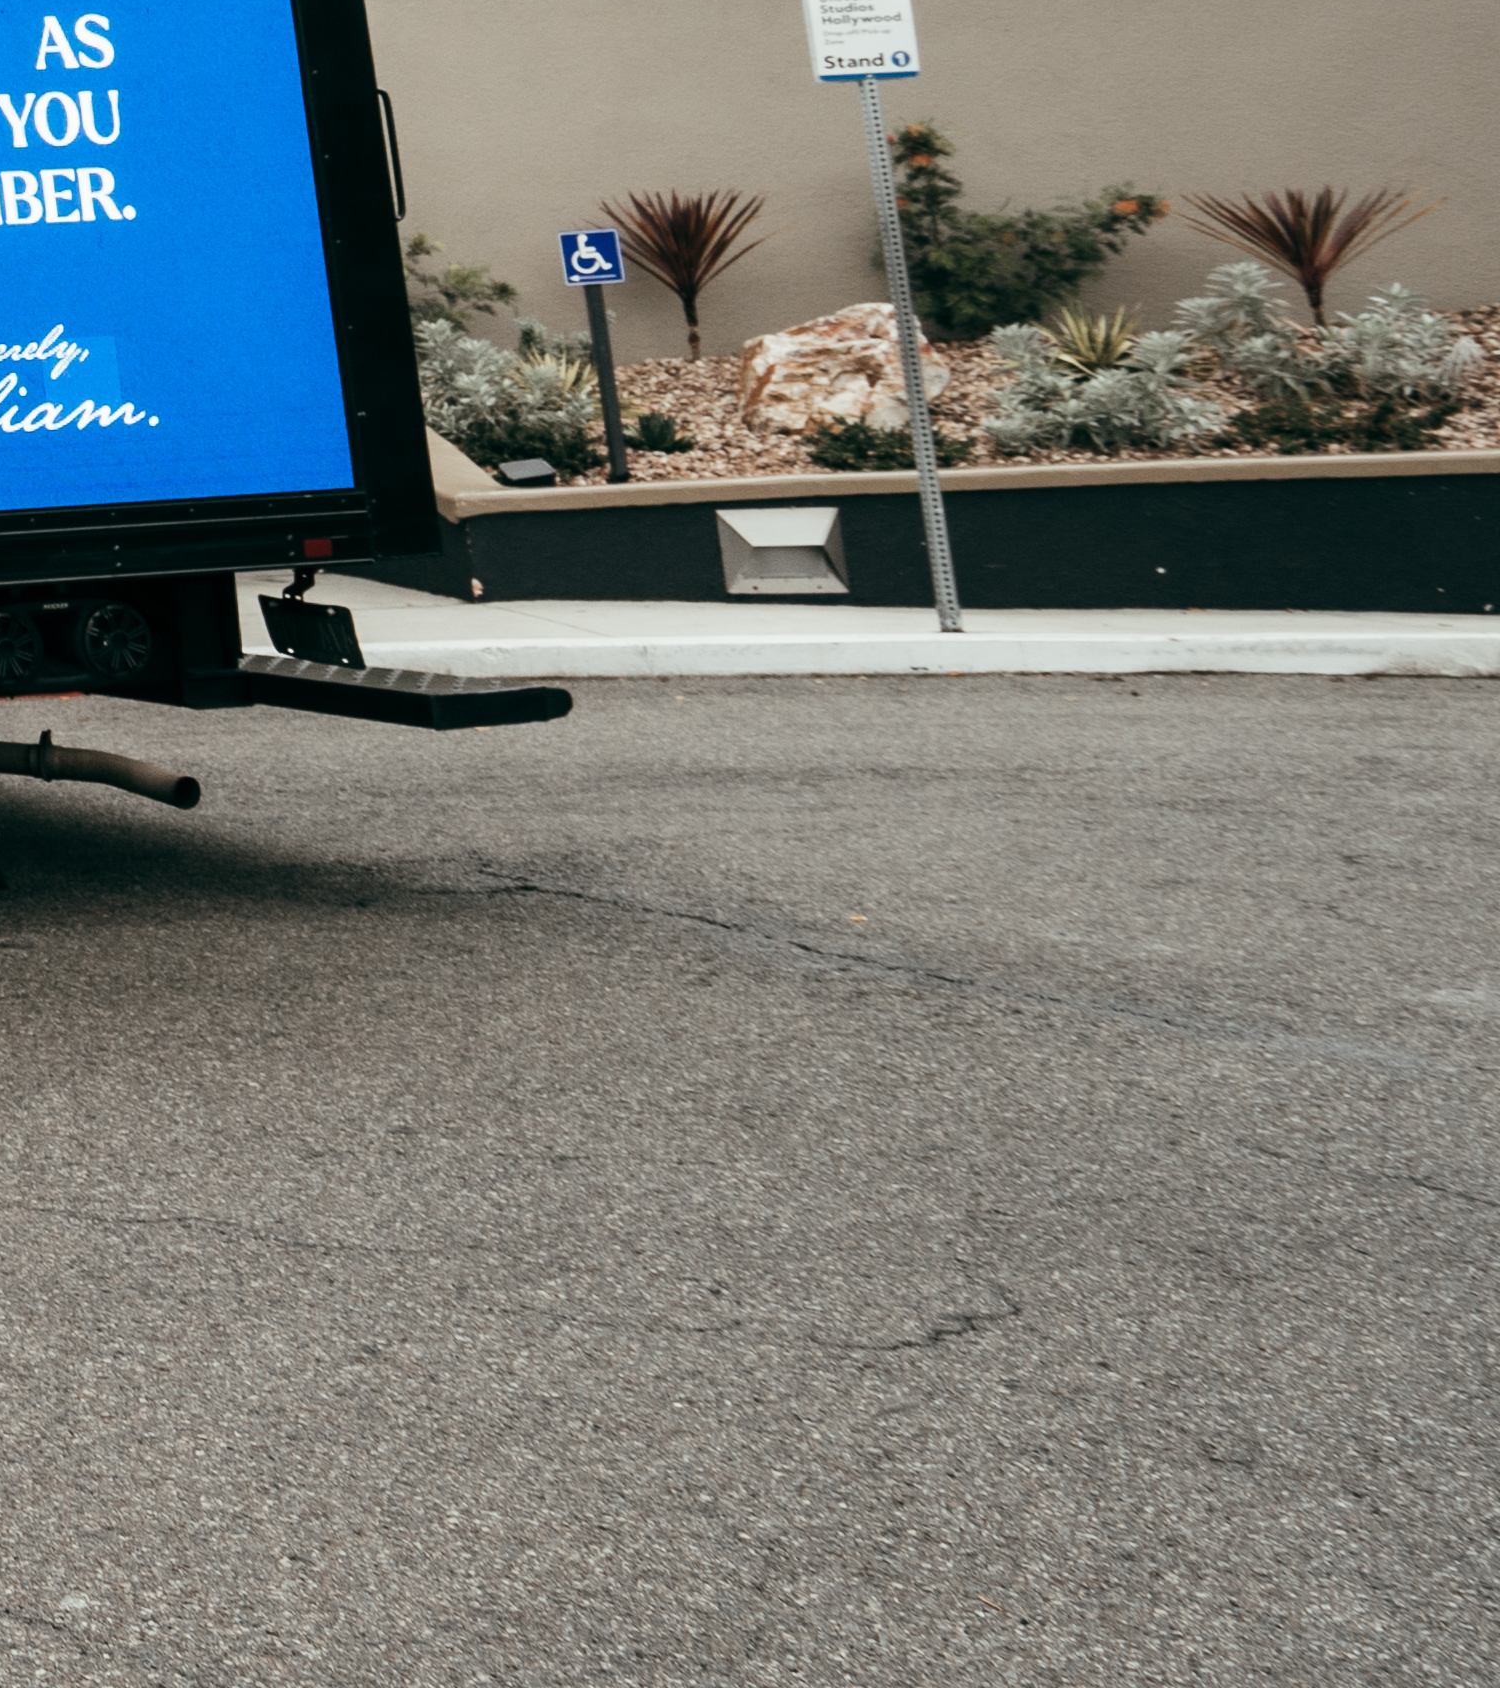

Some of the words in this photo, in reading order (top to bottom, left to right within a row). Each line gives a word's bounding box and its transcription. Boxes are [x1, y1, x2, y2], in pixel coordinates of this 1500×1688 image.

[820, 2, 875, 14] Studios
[822, 12, 902, 27] Hollywood
[36, 14, 115, 70] AS
[824, 52, 885, 69] Stand
